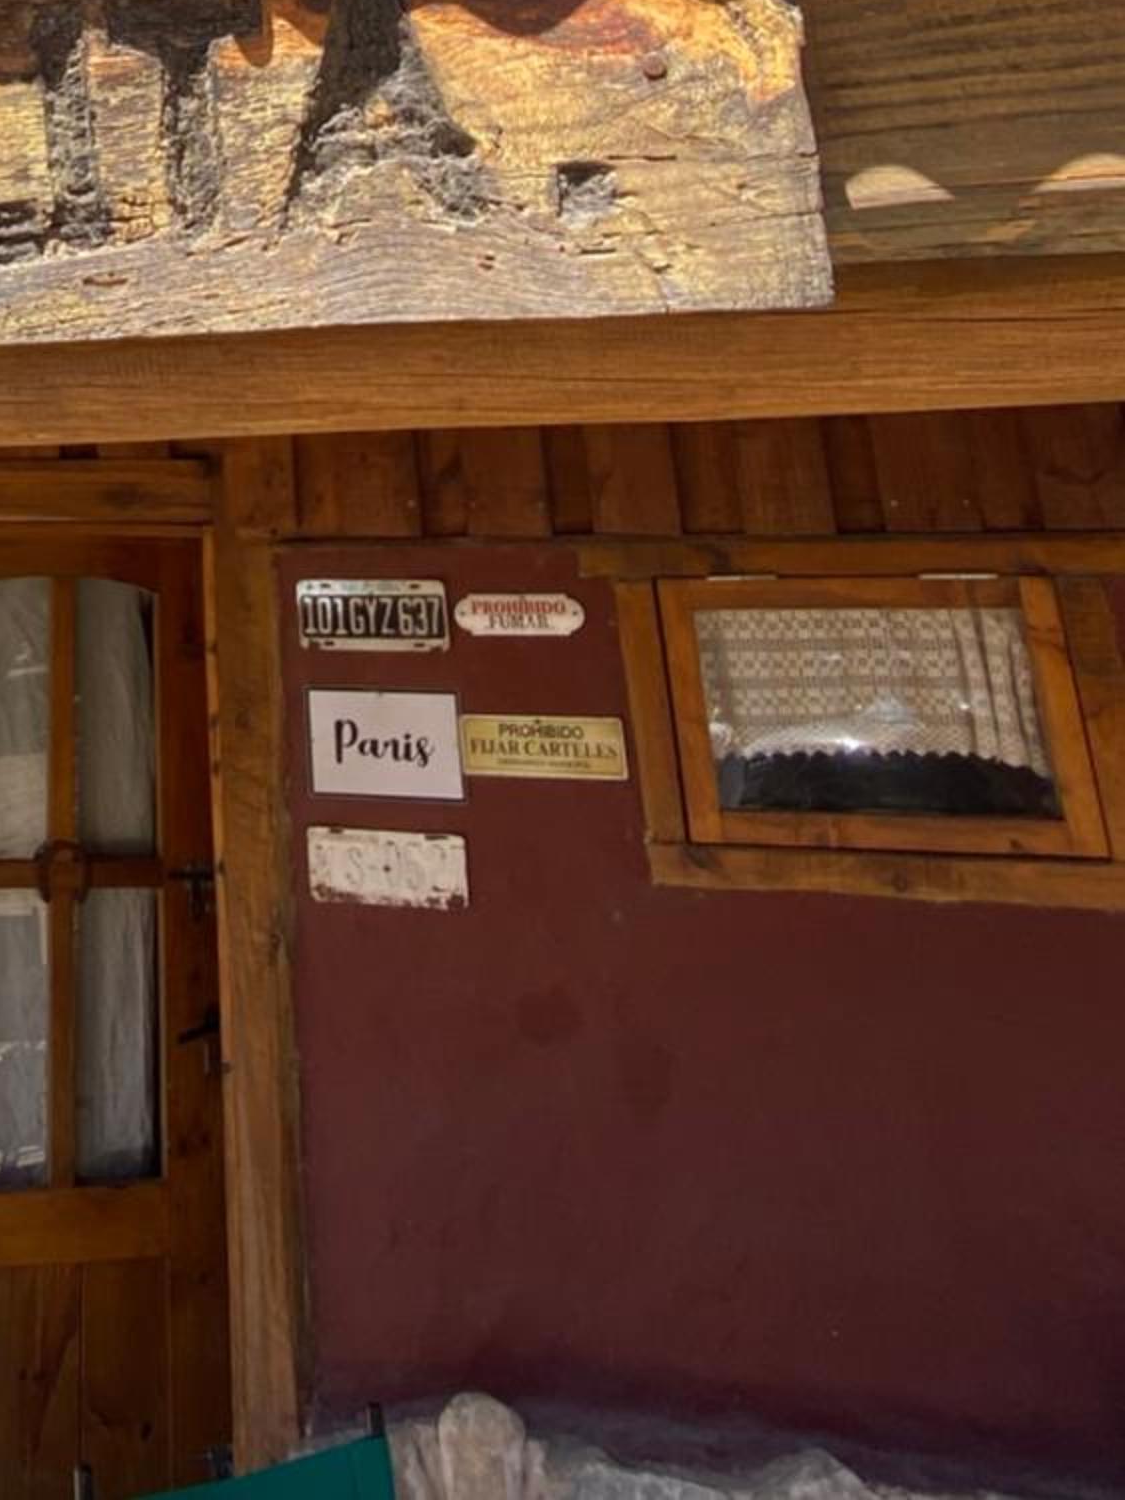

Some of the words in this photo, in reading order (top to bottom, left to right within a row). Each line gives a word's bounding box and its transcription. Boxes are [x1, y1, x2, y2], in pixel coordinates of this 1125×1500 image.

[471, 600, 567, 615] PROHIBIDO
[498, 722, 585, 740] PROHIBIDO
[334, 718, 435, 768] Paris
[470, 738, 521, 756] FIJAR
[523, 739, 620, 759] CARTELES
